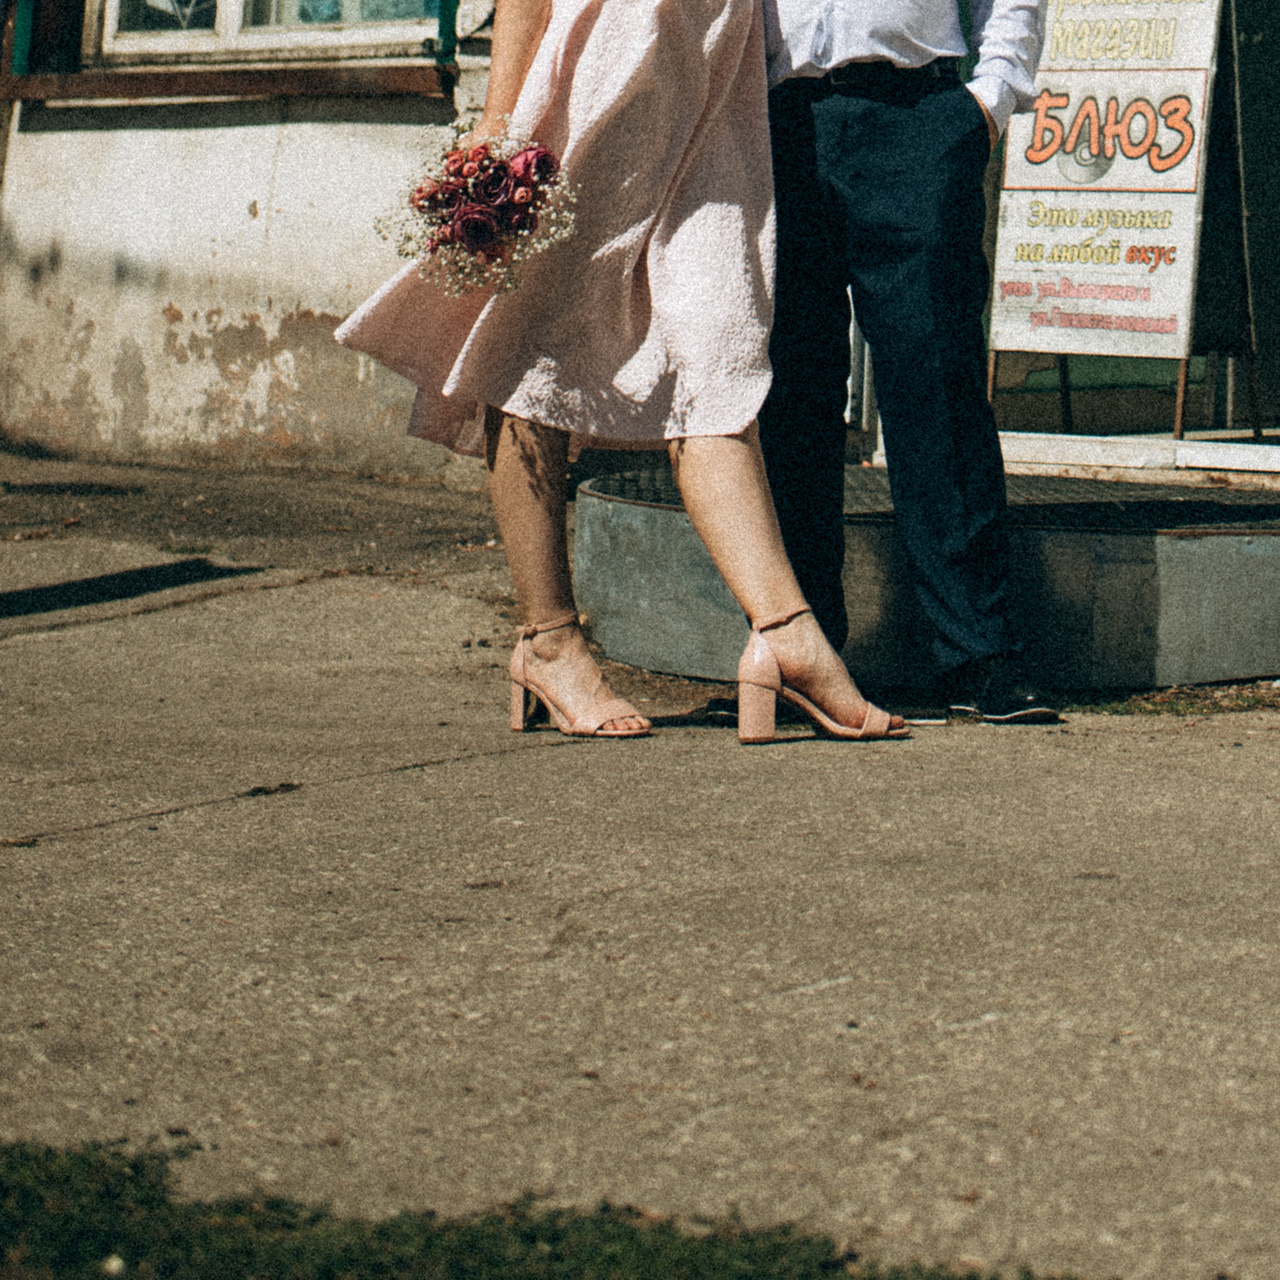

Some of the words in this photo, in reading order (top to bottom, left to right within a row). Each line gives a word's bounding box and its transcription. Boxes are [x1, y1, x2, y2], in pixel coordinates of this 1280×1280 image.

[1049, 17, 1177, 61] магазин
[1025, 89, 1195, 172] БЛЮЗ
[1027, 200, 1079, 228] Это
[1082, 208, 1173, 237] музыка
[1015, 242, 1045, 263] на
[1047, 236, 1121, 264] любой
[1125, 244, 1177, 273] вкус
